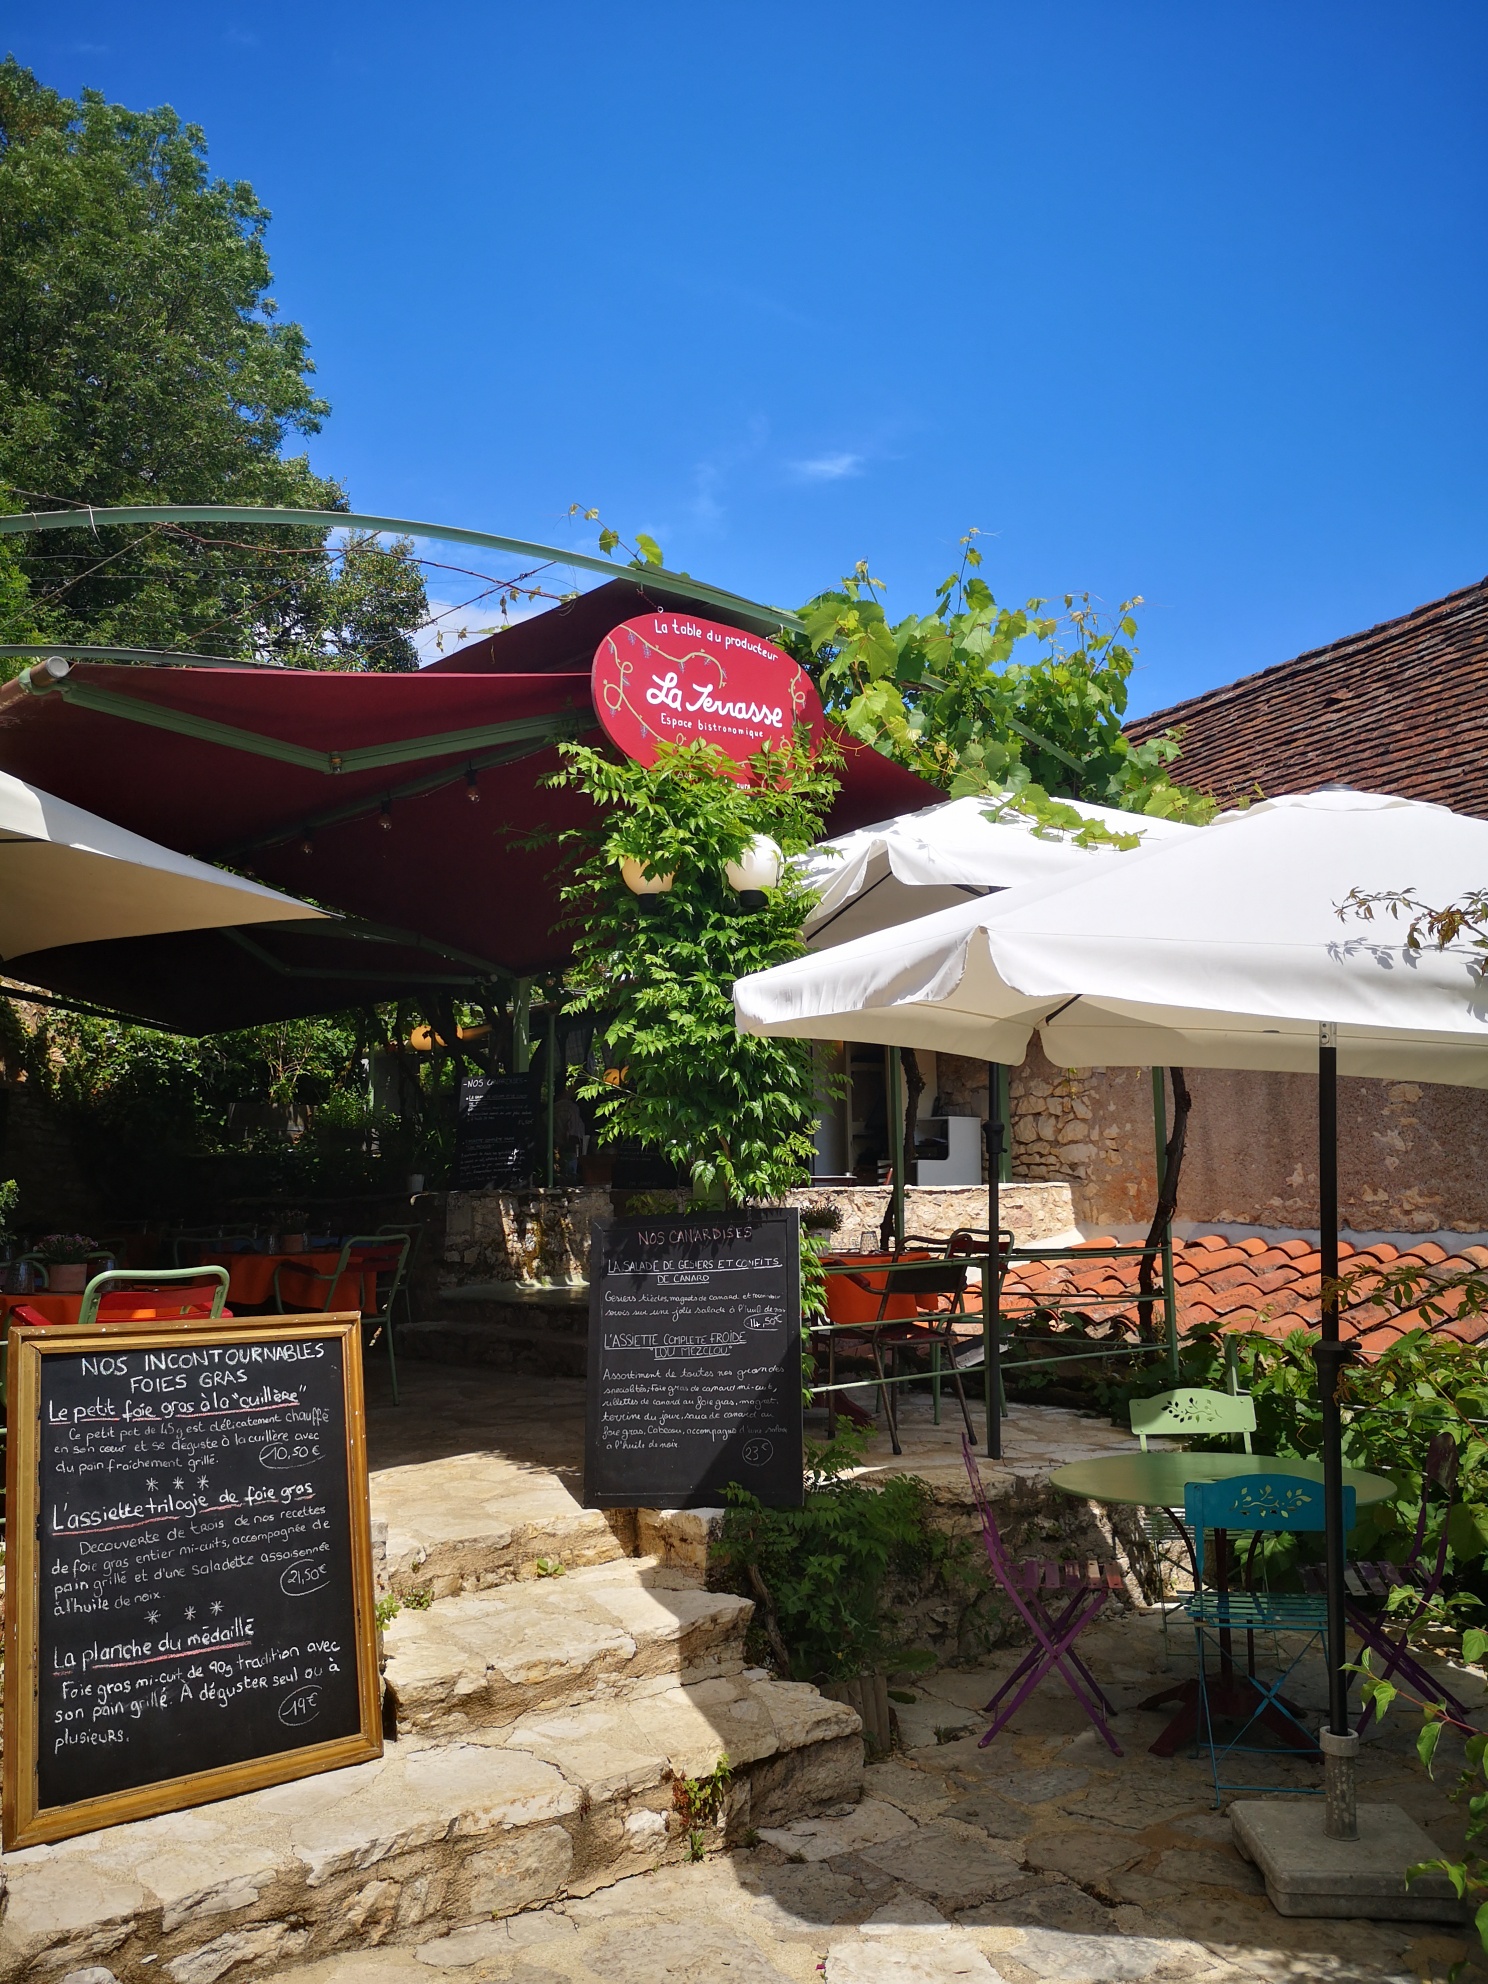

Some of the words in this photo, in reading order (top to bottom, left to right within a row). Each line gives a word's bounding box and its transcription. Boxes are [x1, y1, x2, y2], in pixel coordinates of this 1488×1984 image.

[655, 619, 668, 634] La
[672, 619, 702, 638] table
[707, 630, 721, 641] du
[725, 636, 778, 661] producteur
[646, 672, 682, 711] La
[686, 683, 783, 727] Terrasse
[661, 713, 692, 728] Espace
[698, 719, 763, 739] bistronomique
[638, 1231, 664, 1246] NOS
[669, 1226, 752, 1244] CANARDISES
[608, 1259, 620, 1272] LA
[623, 1260, 659, 1272] SALADE
[663, 1261, 675, 1270] DE
[718, 1259, 733, 1268] ET
[658, 1274, 669, 1283] DE
[673, 1274, 710, 1283] CANARD
[604, 1333, 658, 1348] L'ASSIETTE
[663, 1334, 707, 1344] COMPLETE
[81, 1356, 128, 1376] NOS
[144, 1342, 324, 1372] INCONTOURNABLES
[130, 1374, 187, 1394] FOIES
[199, 1370, 248, 1388] GRAS
[603, 1368, 661, 1380] Assortiment
[665, 1369, 676, 1378] de
[681, 1368, 714, 1377] toutes
[668, 1385, 688, 1396] gras
[49, 1400, 68, 1421] Le
[74, 1401, 116, 1423] petit
[122, 1400, 152, 1419] foie
[161, 1400, 194, 1417] gras
[200, 1392, 210, 1412] à
[214, 1392, 230, 1410] la
[54, 1444, 68, 1454] en
[73, 1445, 95, 1454] son
[134, 1441, 146, 1452] et
[152, 1442, 166, 1450] se
[172, 1439, 218, 1456] déguste
[222, 1436, 230, 1446] à
[235, 1433, 247, 1444] la
[248, 1430, 288, 1442] cuillère
[294, 1430, 320, 1440] avec
[69, 1428, 81, 1440] Ce
[86, 1426, 115, 1446] petit
[120, 1426, 140, 1442] pot
[144, 1426, 156, 1435] de
[186, 1422, 203, 1434] est
[210, 1414, 282, 1432] délicatement
[649, 1440, 658, 1448] de
[56, 1462, 74, 1474] du
[78, 1462, 104, 1475] pain
[52, 1502, 144, 1530] L'assiette
[146, 1493, 208, 1518] trilogie
[219, 1490, 238, 1504] de
[244, 1486, 276, 1505] foie
[280, 1482, 313, 1504] gras
[167, 1528, 186, 1540] de
[234, 1514, 250, 1526] de
[254, 1513, 274, 1524] nos
[280, 1504, 326, 1518] recettes
[52, 1562, 68, 1574] de
[72, 1562, 98, 1577] foie
[104, 1557, 129, 1574] gras
[136, 1550, 175, 1564] entier
[232, 1523, 306, 1545] accompagnée
[312, 1518, 330, 1530] de
[54, 1580, 88, 1599] pain
[94, 1570, 127, 1596] grillé
[134, 1570, 148, 1582] et
[154, 1566, 186, 1580] d'une
[114, 1594, 130, 1608] de
[54, 1649, 76, 1668] La
[82, 1639, 152, 1672] planche
[158, 1632, 182, 1651] du
[62, 1682, 92, 1700] Foie
[98, 1680, 132, 1704] gras
[135, 1670, 182, 1690] mi-cuit
[188, 1666, 203, 1679] de
[208, 1661, 233, 1677] 90g
[238, 1646, 300, 1670] tradition
[307, 1640, 340, 1652] avec
[54, 1708, 84, 1724] son
[92, 1702, 124, 1722] pain
[272, 1669, 298, 1685] seul
[304, 1666, 322, 1679] ou
[329, 1658, 340, 1672] à
